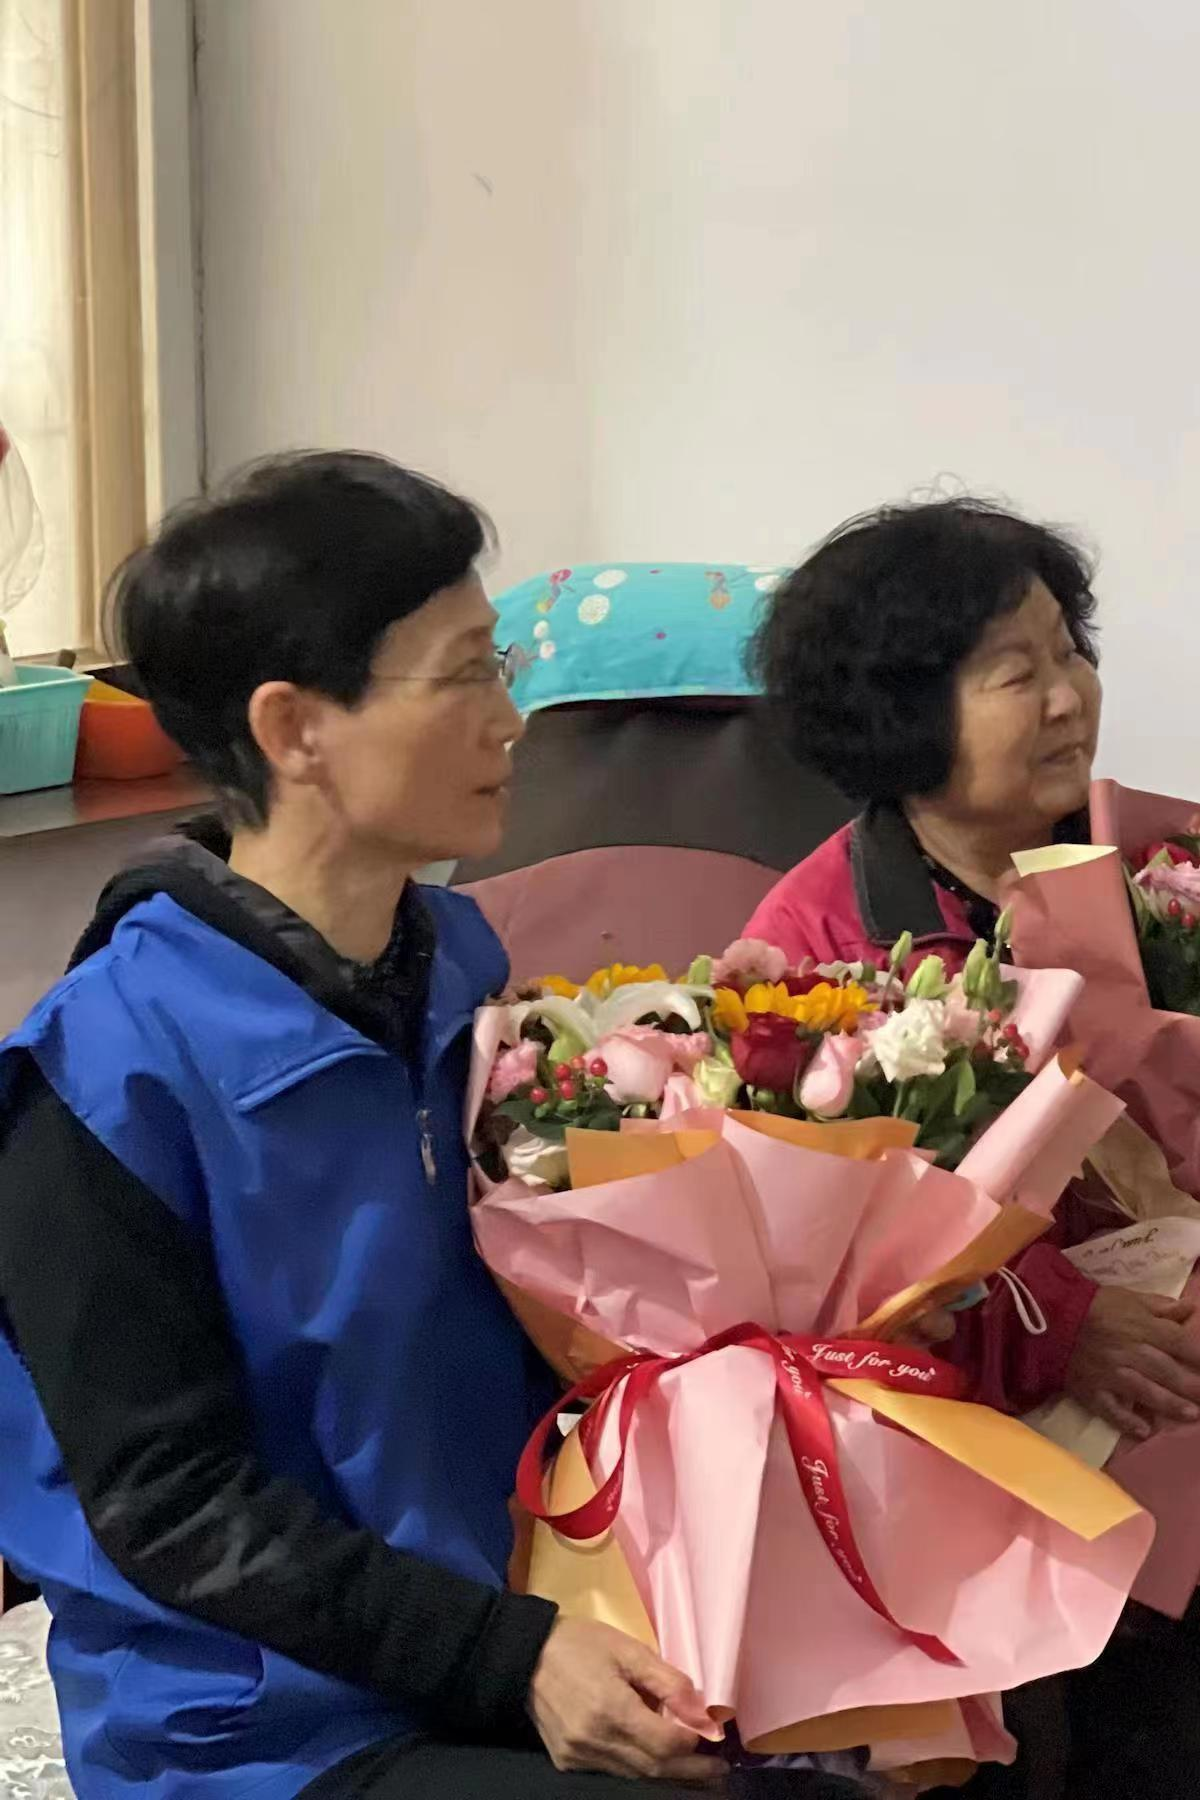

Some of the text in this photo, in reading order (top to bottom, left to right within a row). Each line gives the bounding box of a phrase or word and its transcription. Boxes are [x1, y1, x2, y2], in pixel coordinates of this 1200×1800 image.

[807, 1343, 855, 1363] Just
[847, 1351, 891, 1370] for
[801, 1456, 830, 1504] Just
